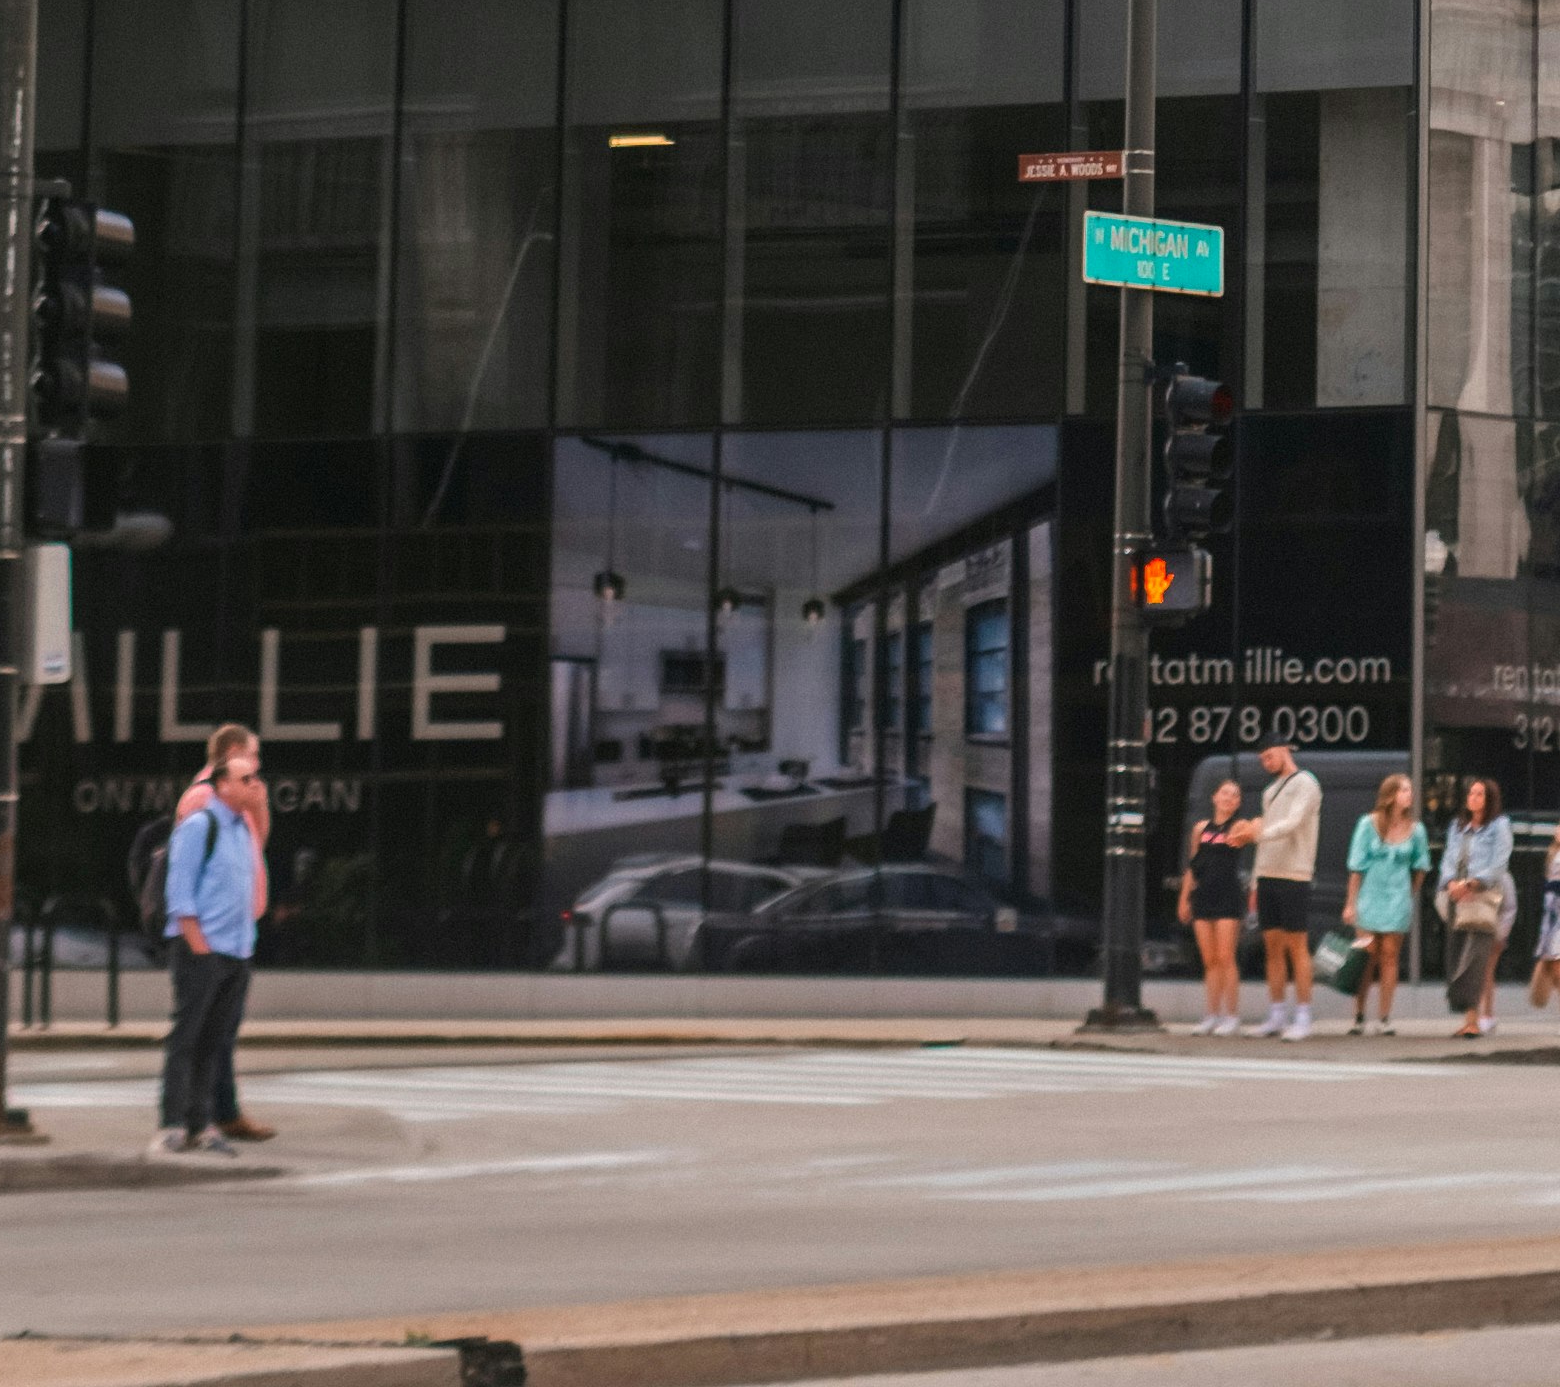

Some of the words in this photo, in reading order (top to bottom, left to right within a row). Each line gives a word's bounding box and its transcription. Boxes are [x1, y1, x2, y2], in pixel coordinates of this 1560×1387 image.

[1110, 225, 1189, 260] MICHIGAN
[1162, 263, 1171, 281] E
[1093, 647, 1391, 686] rtatmillie.com
[1143, 706, 1178, 743] 12
[1271, 705, 1370, 743] 0300
[1513, 713, 1554, 752] 312
[144, 779, 360, 813] MGAN
